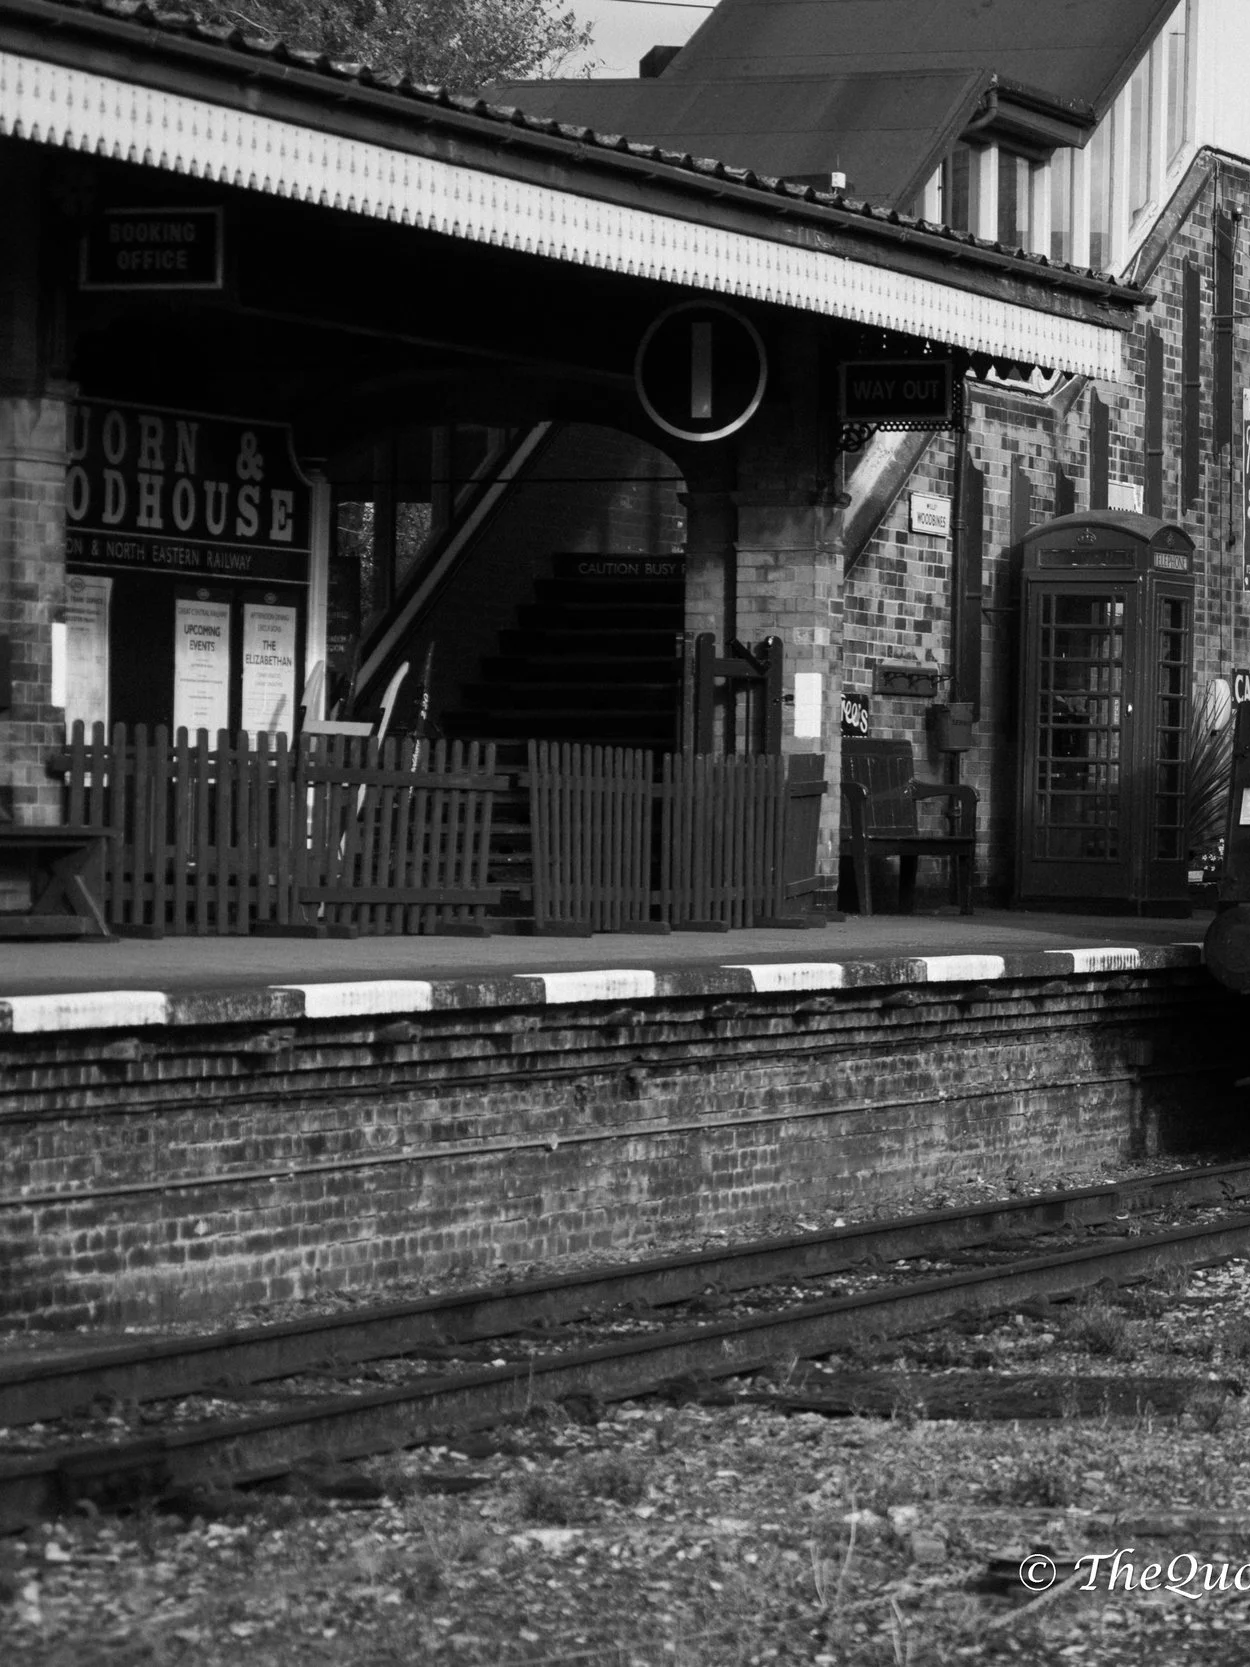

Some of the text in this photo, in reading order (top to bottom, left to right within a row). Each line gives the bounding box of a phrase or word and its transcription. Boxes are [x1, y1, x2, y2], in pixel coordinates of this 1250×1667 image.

[109, 222, 197, 243] BOOKING
[116, 250, 188, 270] OFFICE
[852, 379, 940, 400] WAY OUT
[66, 405, 265, 482] UORN &
[66, 465, 295, 542] ODHOUSE
[106, 540, 145, 561] NORTH
[152, 545, 199, 566] EASTERN
[206, 550, 252, 569] RAILWAY
[578, 562, 640, 575] CAUTION
[644, 563, 677, 575] BUSY
[184, 624, 221, 637] UPCOMING
[189, 640, 216, 652] EVENTS
[262, 640, 277, 651] THE
[245, 654, 293, 666] ELIZABETHAN
